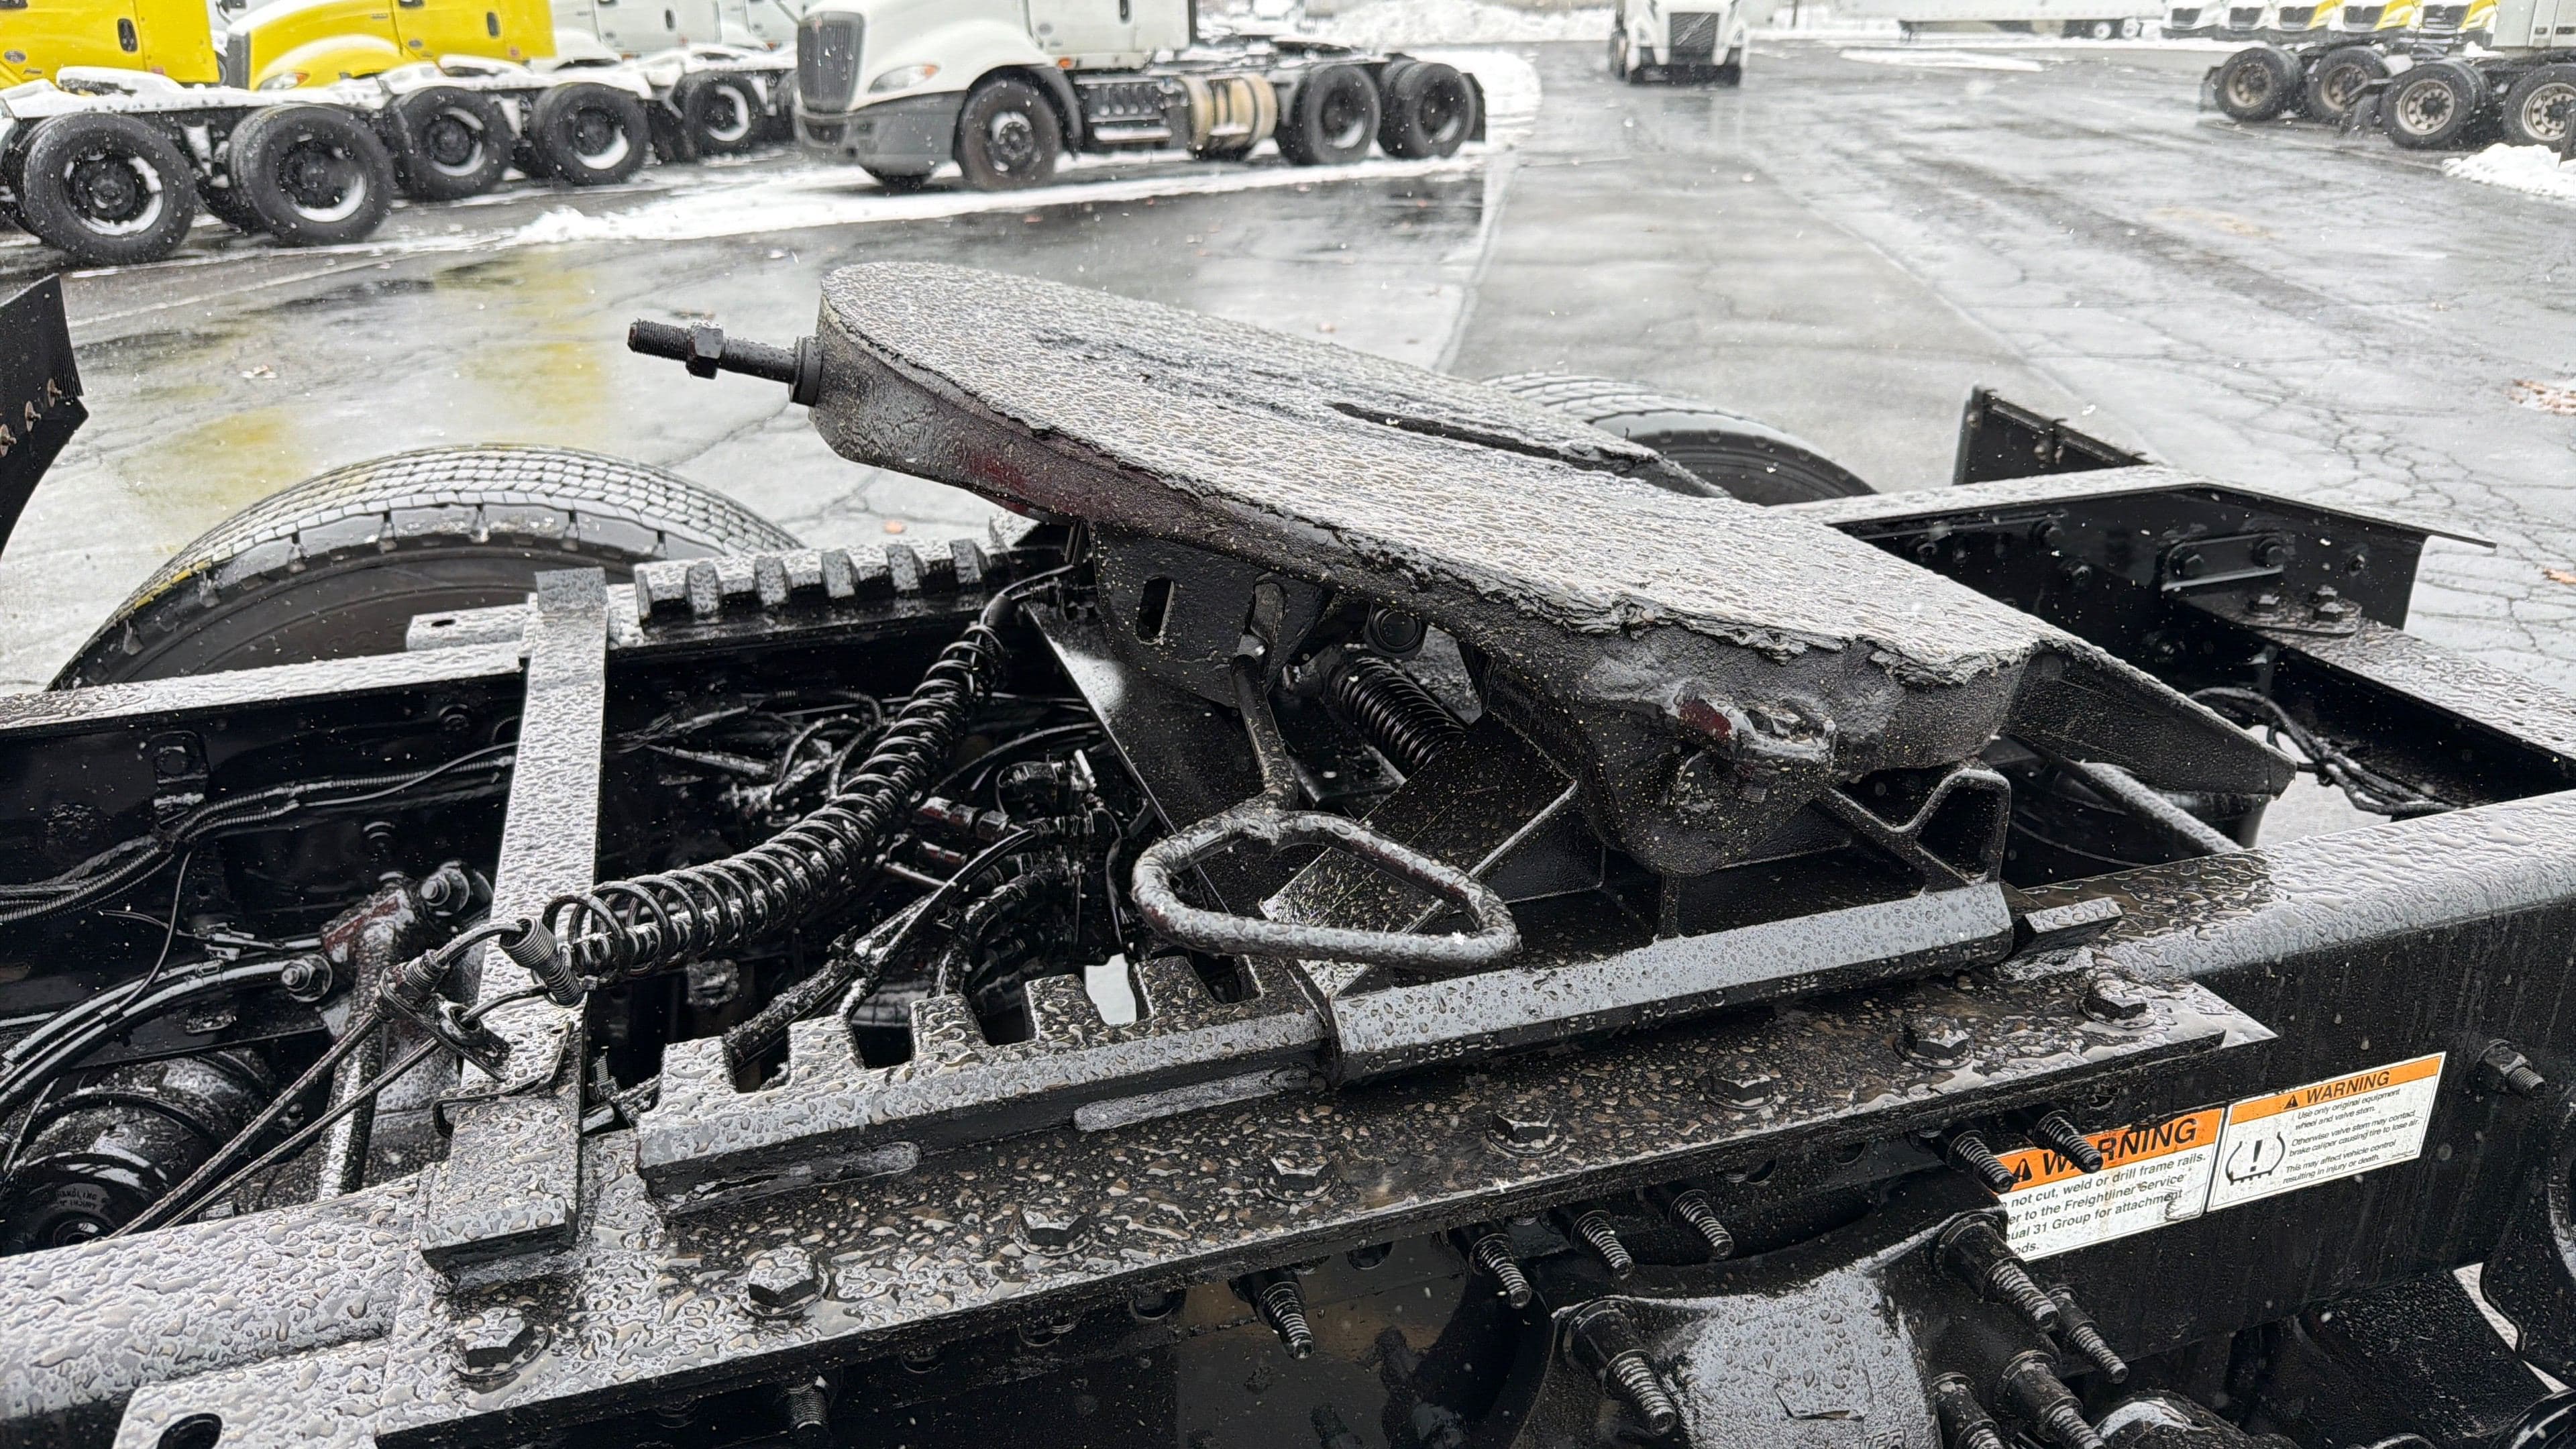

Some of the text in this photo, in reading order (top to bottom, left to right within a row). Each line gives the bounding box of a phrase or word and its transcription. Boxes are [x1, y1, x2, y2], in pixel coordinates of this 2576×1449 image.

[2298, 1087, 2400, 1120] Use only original equipment
[2307, 1071, 2390, 1104] WARNING
[2292, 1110, 2416, 1146] Otherwise valve stem may contact
[2295, 1118, 2318, 1130] wheel
[2318, 1114, 2334, 1125] and
[2334, 1111, 2355, 1120] valve
[2043, 1118, 2197, 1176] WRNING
[2286, 1138, 2397, 1173] This may affect vehicle control
[2289, 1146, 2311, 1157] brake
[2312, 1139, 2338, 1150] caliper
[2338, 1132, 2369, 1144] causing
[2369, 1128, 2381, 1137] tire
[2392, 1122, 2408, 1131] lose
[2011, 1194, 2033, 1208] not
[2035, 1188, 2059, 1201] cut,
[2063, 1178, 2093, 1194] weld
[2096, 1177, 2110, 1187] or
[2112, 1168, 2137, 1183] drill
[2140, 1161, 2175, 1176] frame
[2178, 1152, 2206, 1167] rails.
[2282, 1171, 2316, 1184] resulting
[2326, 1163, 2348, 1173] injury
[2006, 1188, 2183, 1241] nual 31 Group for attachment
[2025, 1210, 2037, 1220] to
[2041, 1205, 2061, 1216] the
[2064, 1185, 2137, 1211] Freightliner
[2139, 1175, 2185, 1192] Service
